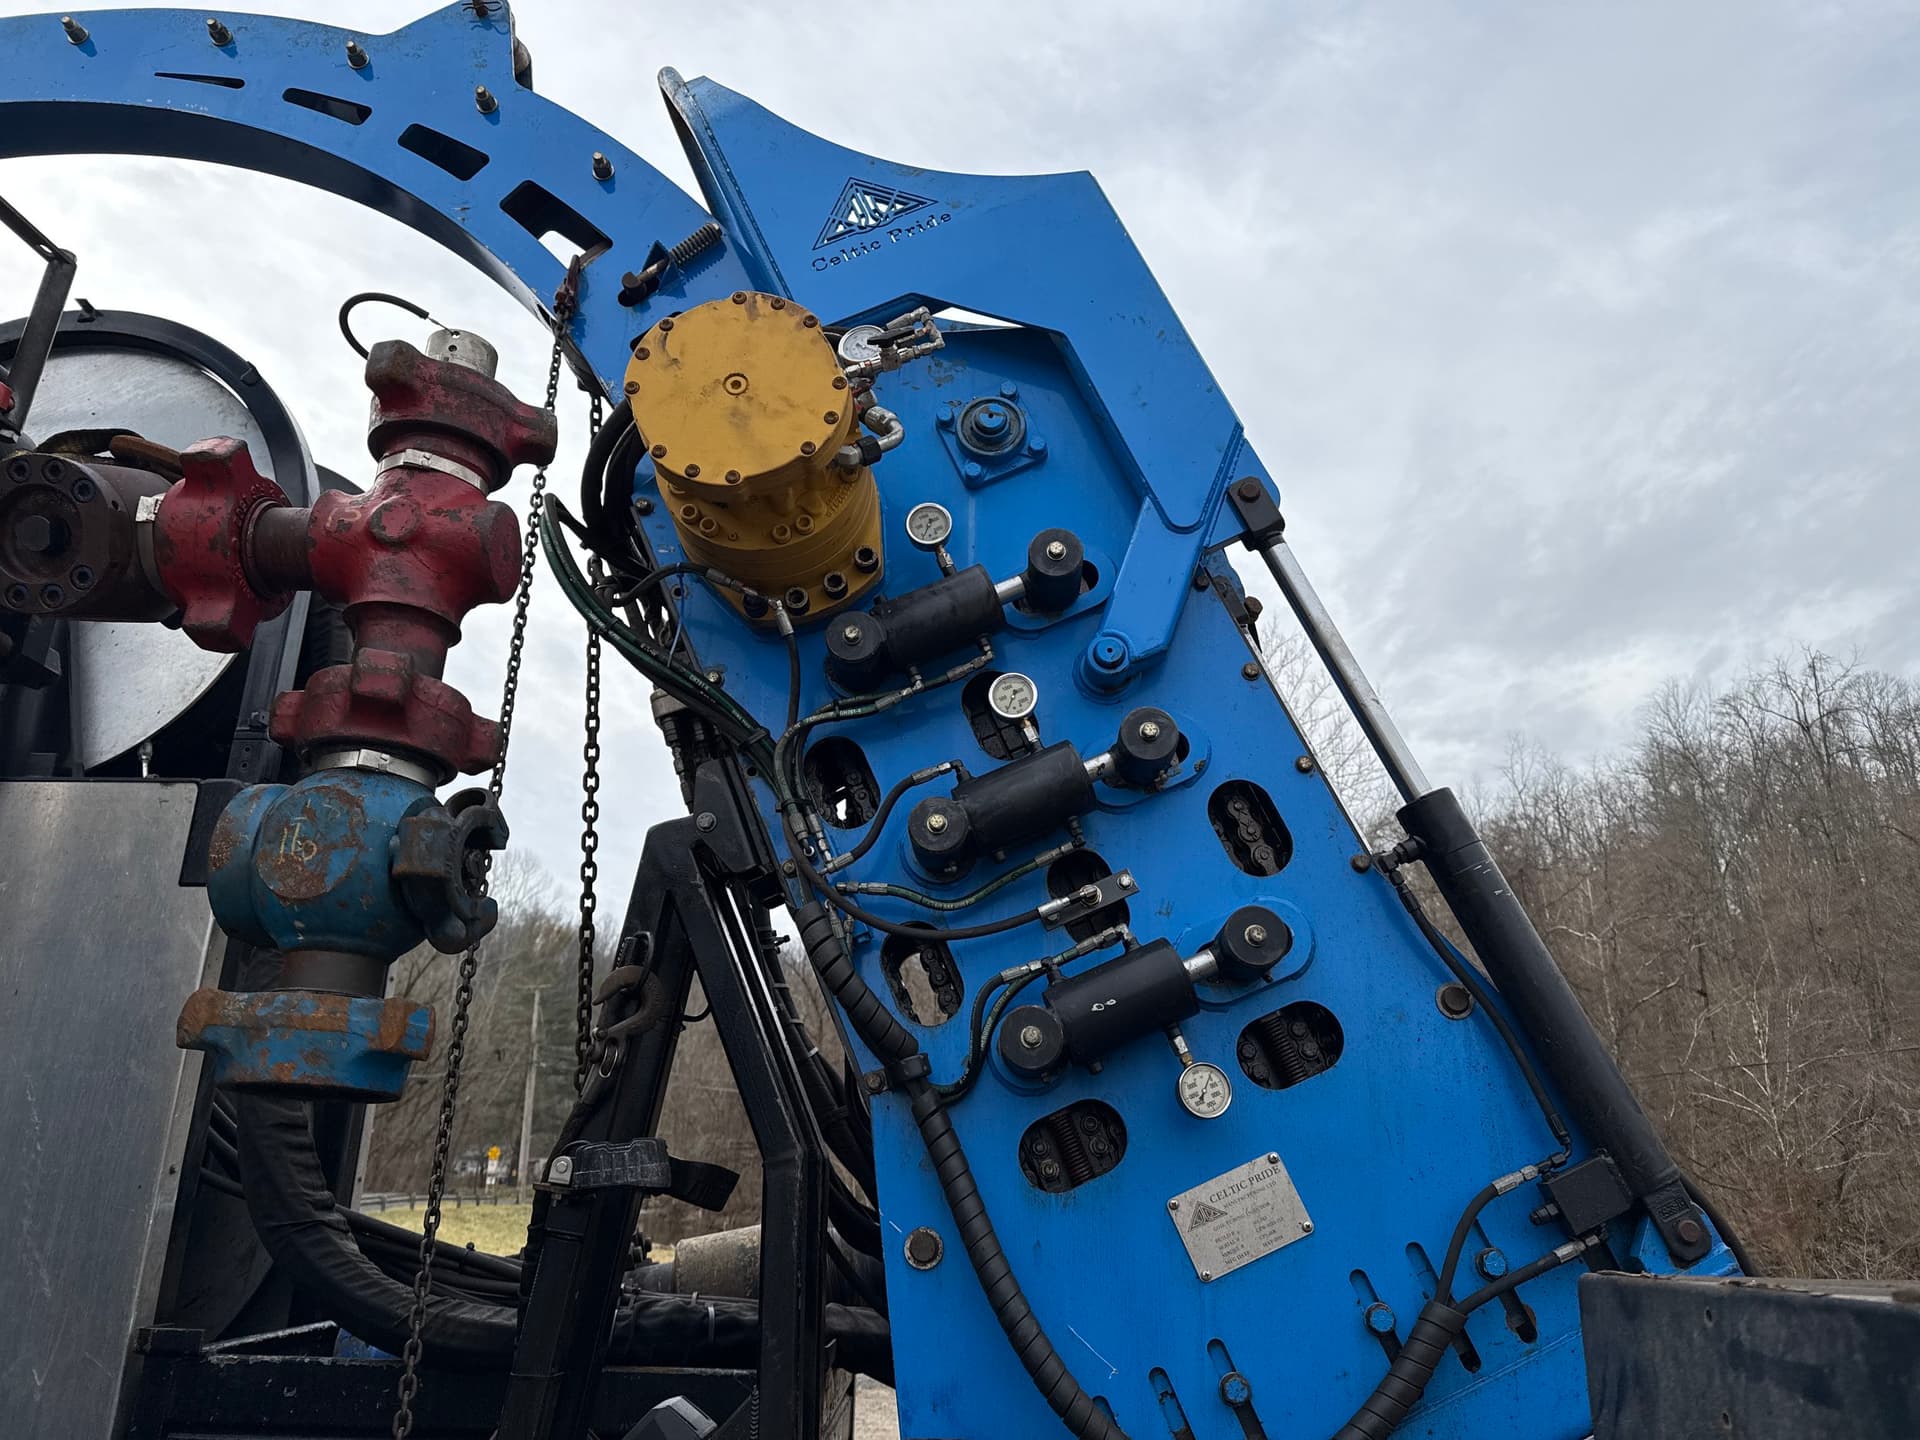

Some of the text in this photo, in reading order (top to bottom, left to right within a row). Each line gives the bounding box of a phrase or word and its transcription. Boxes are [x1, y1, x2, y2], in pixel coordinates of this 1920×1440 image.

[812, 213, 952, 272] Celtic Pride
[1209, 1164, 1281, 1204] CELTIC PRIDE
